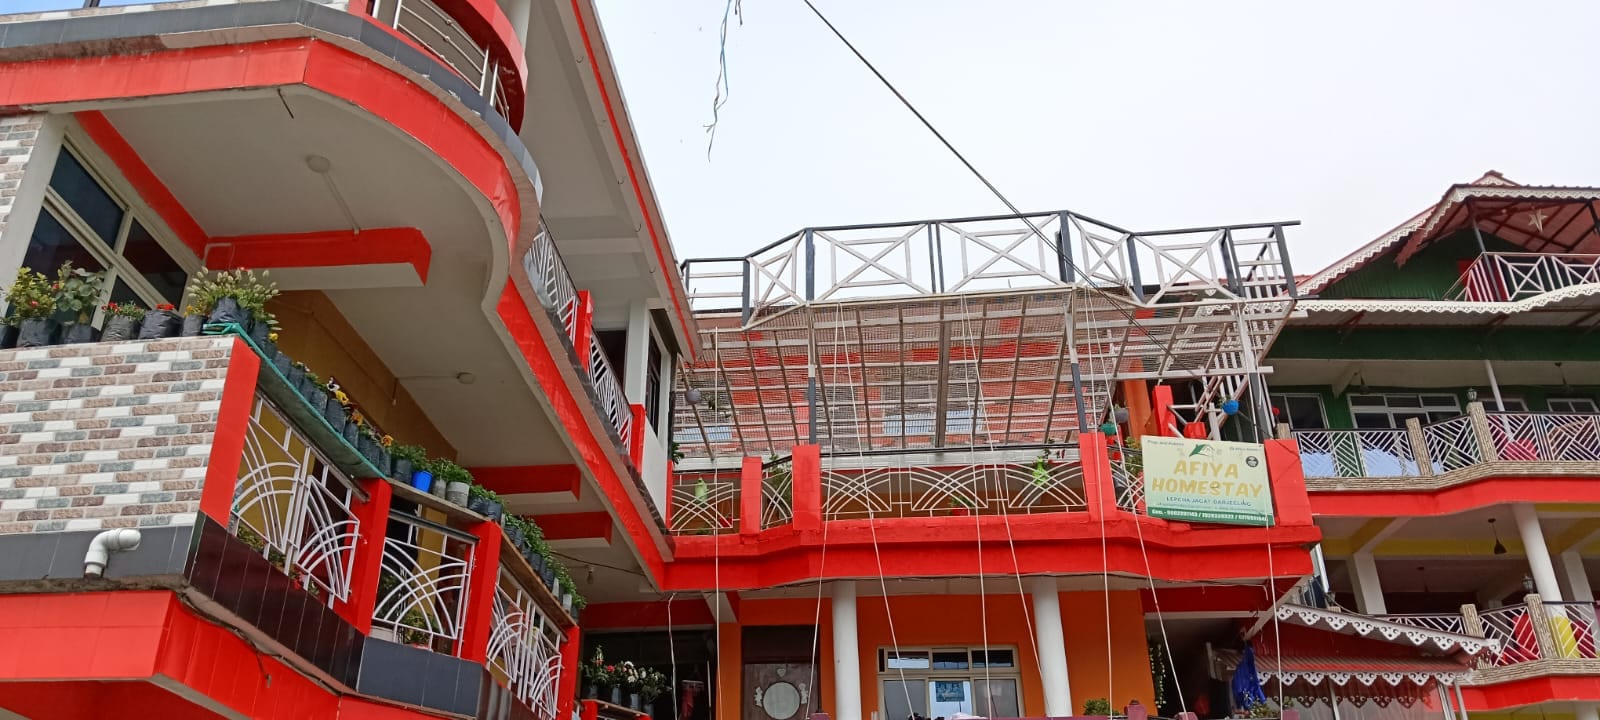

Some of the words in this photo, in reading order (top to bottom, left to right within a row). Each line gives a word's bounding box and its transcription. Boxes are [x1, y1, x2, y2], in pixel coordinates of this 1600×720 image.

[1173, 460, 1239, 479] AFIYA
[1151, 477, 1263, 498] HOMESTAY
[1213, 498, 1251, 506] DARJEELING
